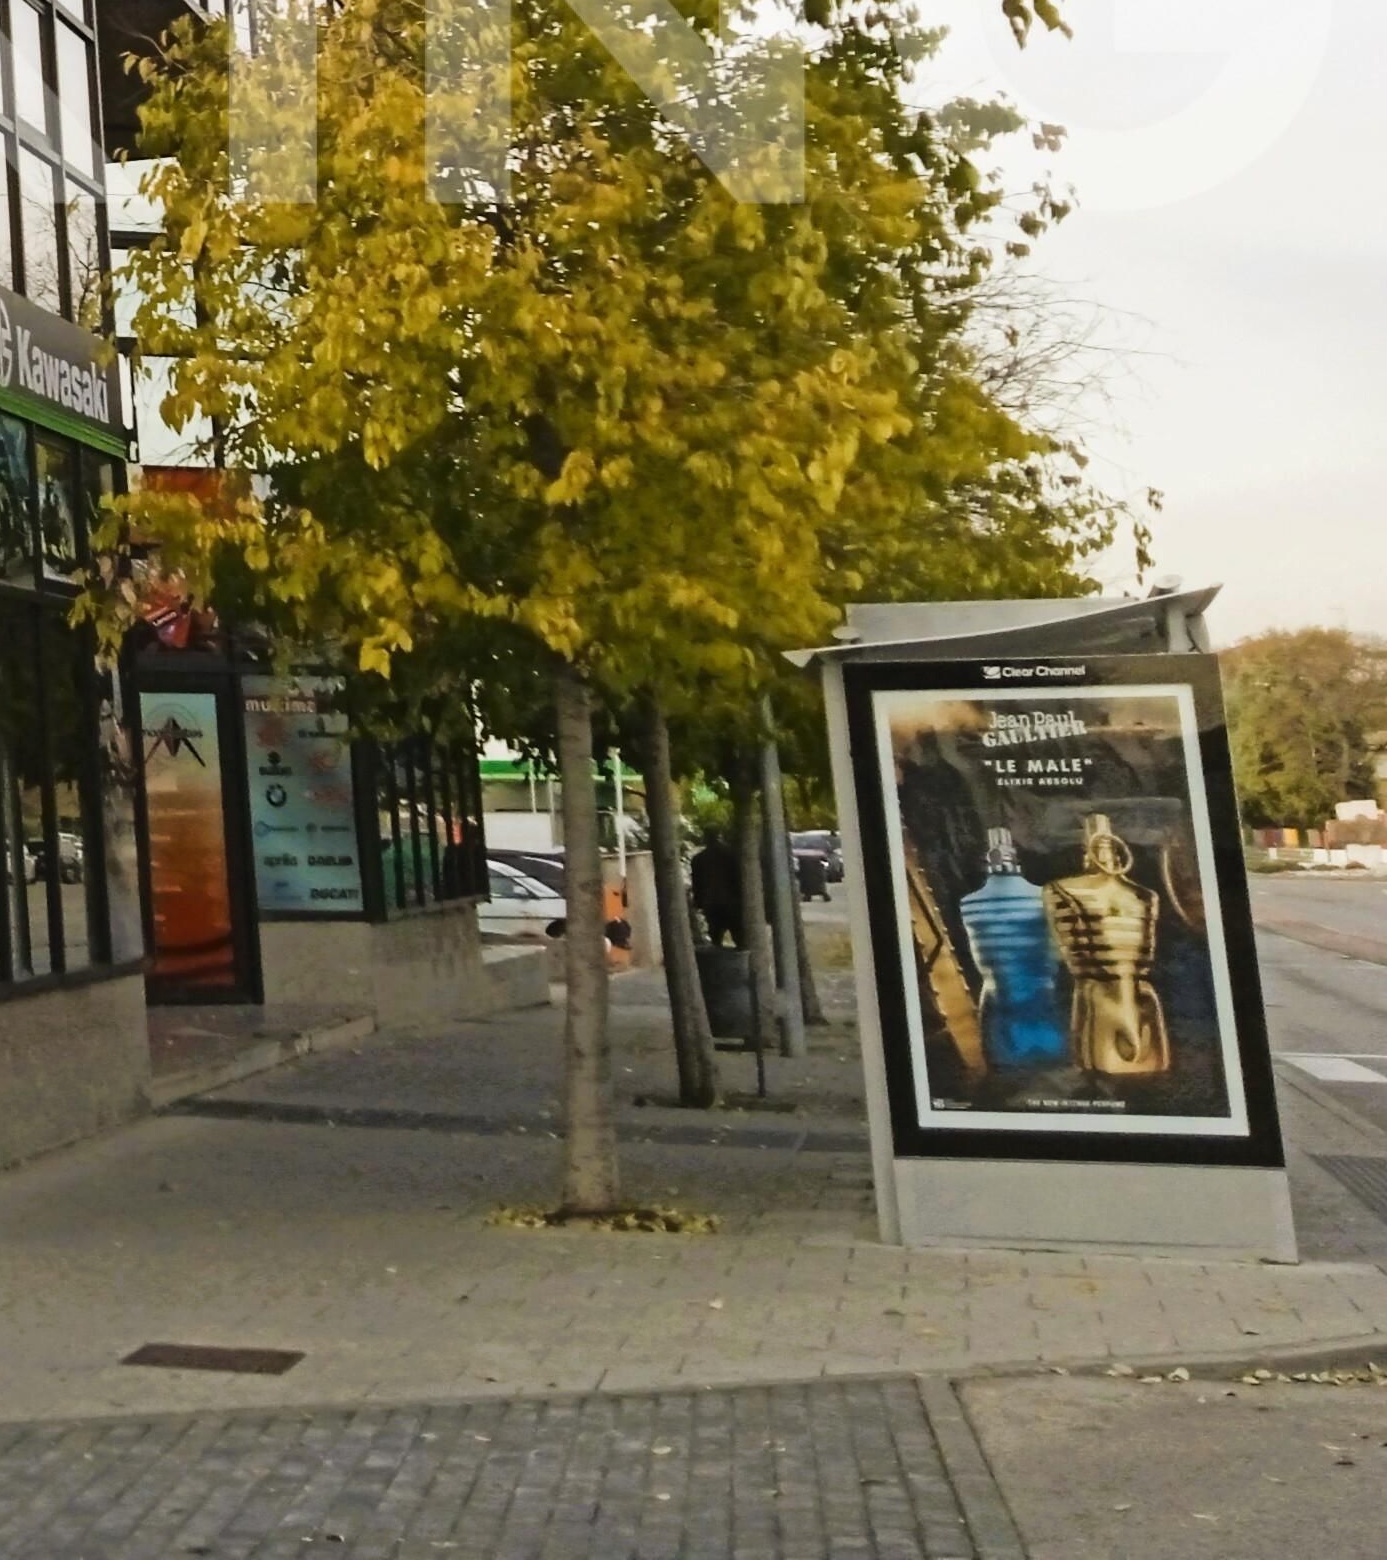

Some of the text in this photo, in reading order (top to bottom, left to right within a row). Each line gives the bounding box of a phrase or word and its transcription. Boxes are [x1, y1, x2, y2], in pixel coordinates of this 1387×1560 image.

[15, 325, 110, 424] Kawasaki
[1002, 665, 1086, 678] Clear Channel
[989, 710, 1075, 729] Jean Paul
[982, 720, 1087, 748] GAULTIER
[1038, 777, 1084, 786] ABSOLU
